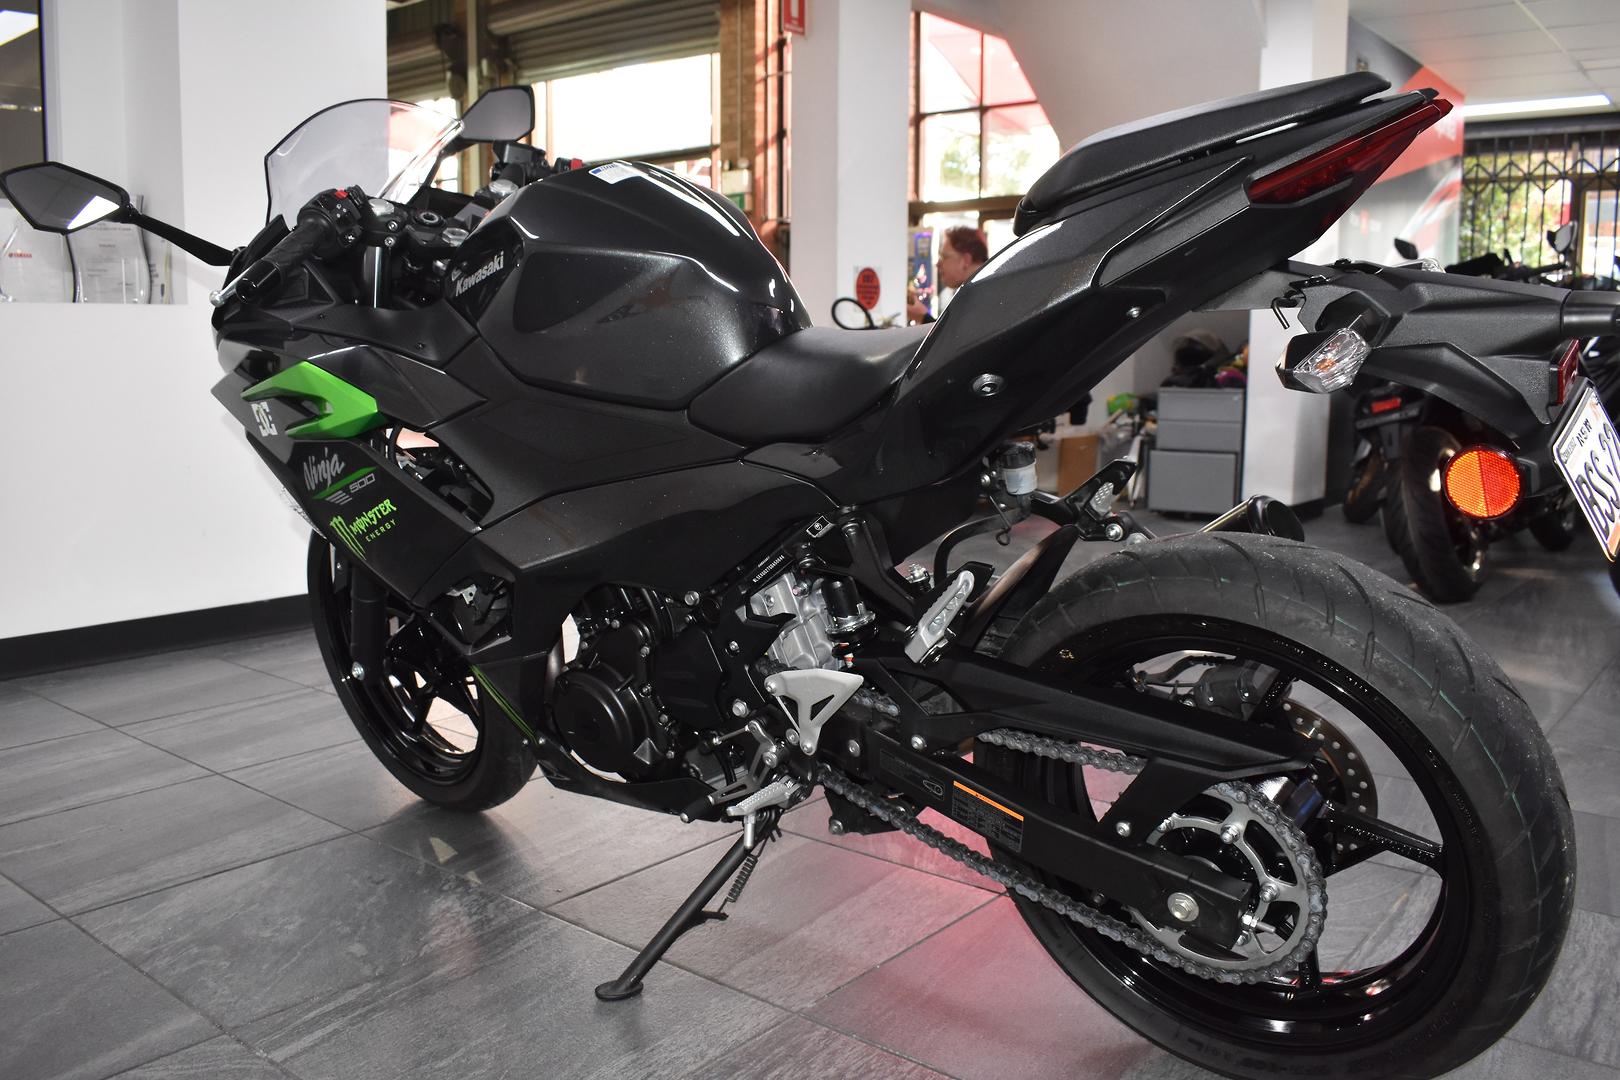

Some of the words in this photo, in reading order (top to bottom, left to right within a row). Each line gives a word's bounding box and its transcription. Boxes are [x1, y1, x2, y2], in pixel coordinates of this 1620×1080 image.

[455, 250, 504, 297] Kawasaki
[1576, 418, 1592, 447] NSW
[303, 447, 345, 491] Ninja
[349, 473, 376, 493] 500
[349, 498, 397, 536] MONSTER
[365, 519, 396, 542] ENERGY
